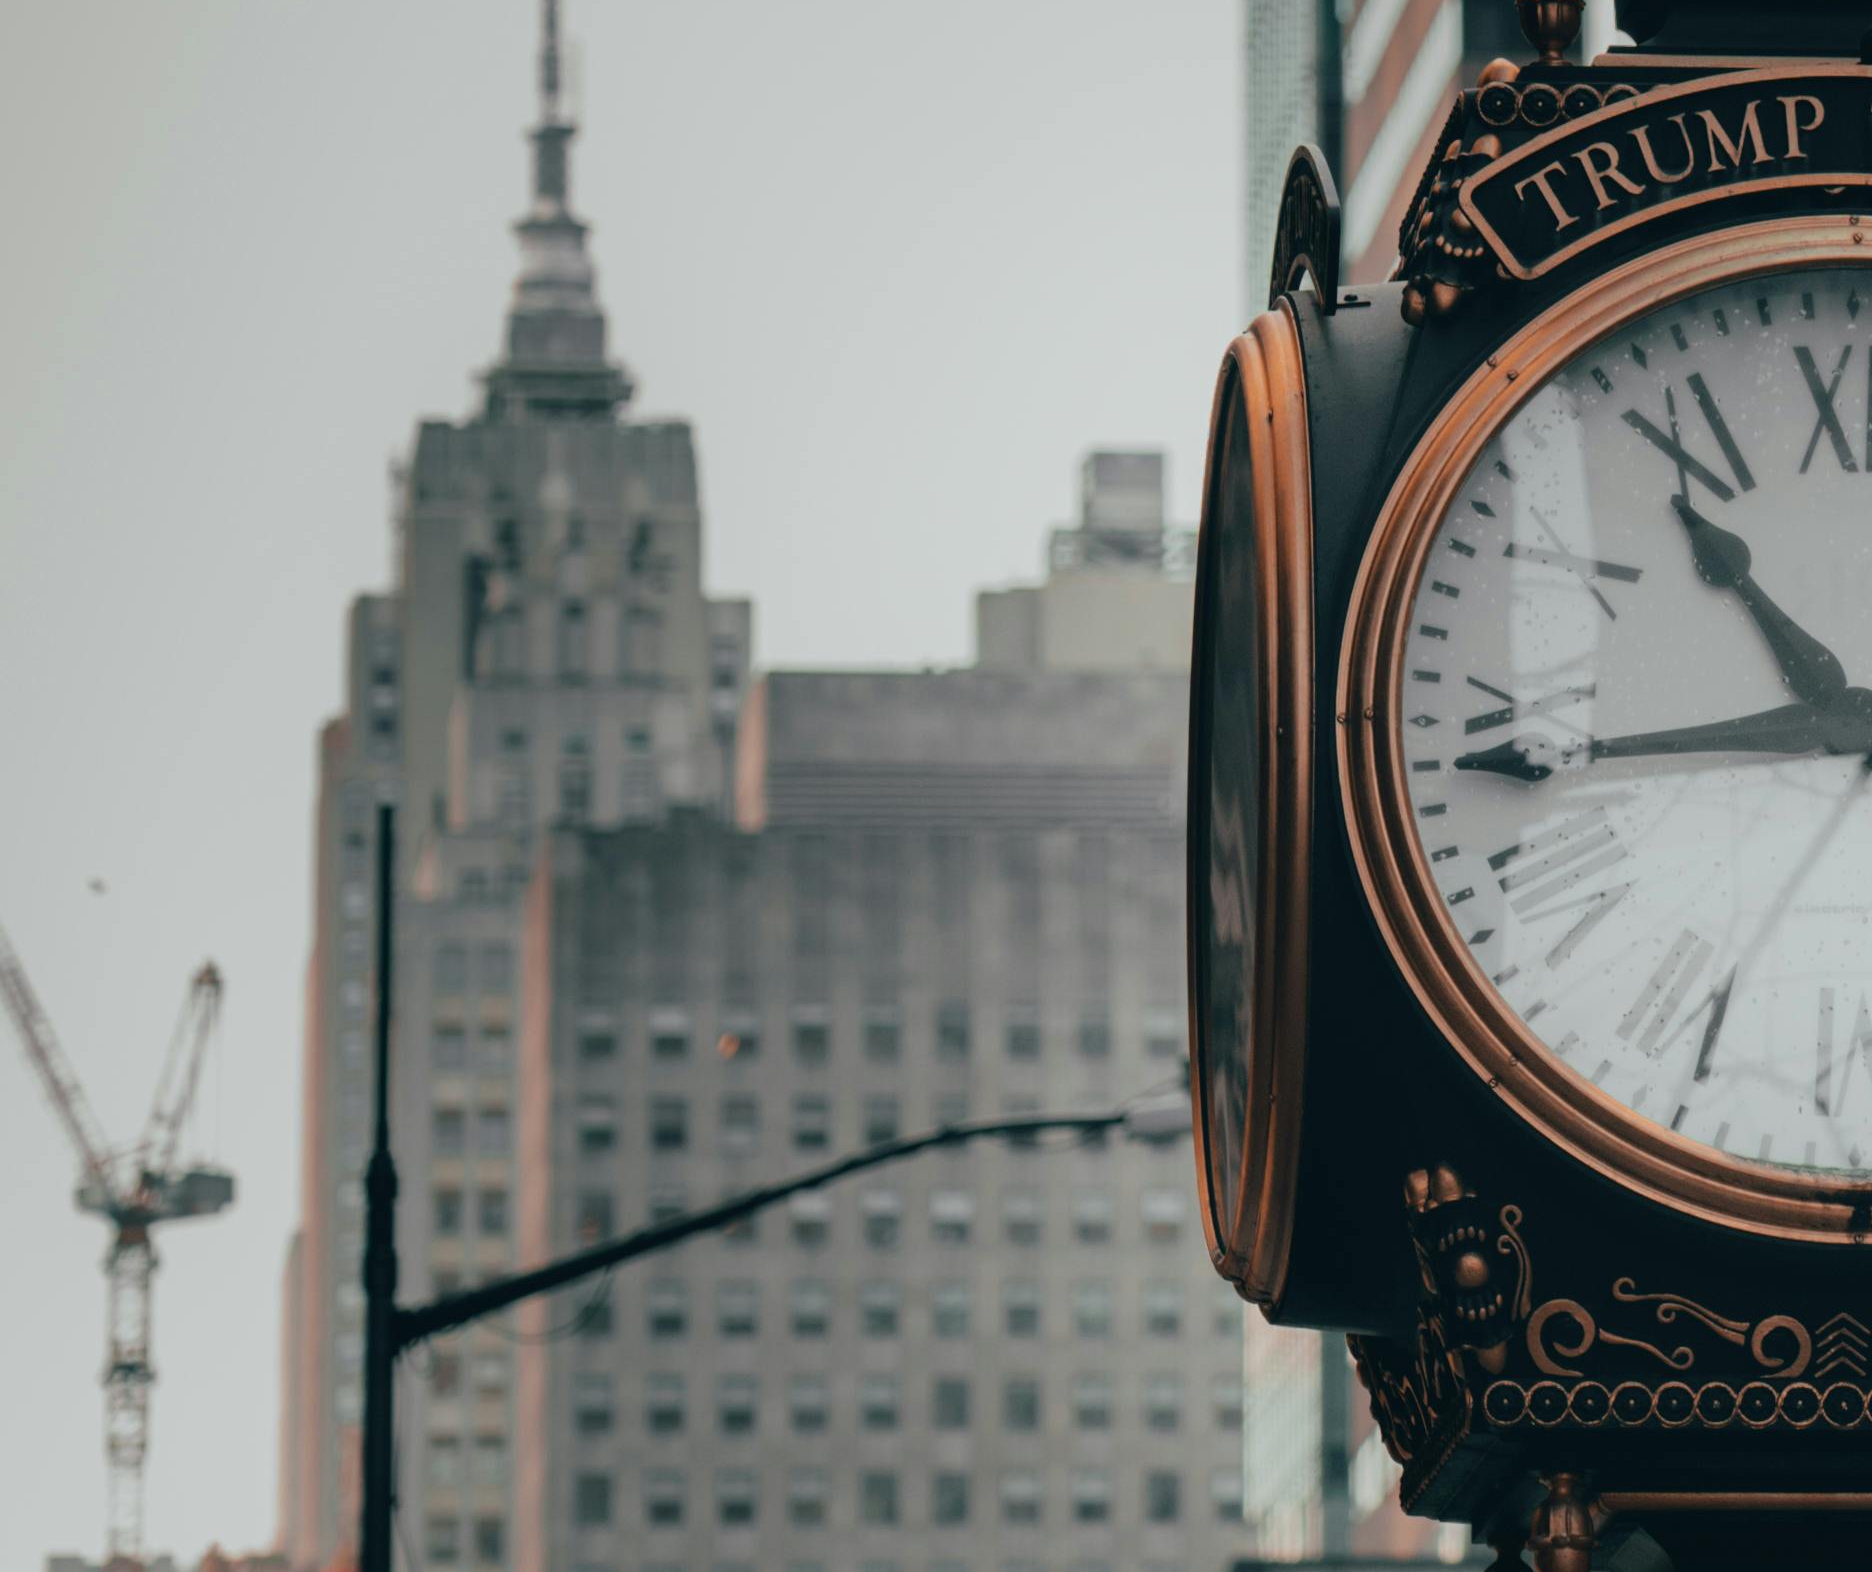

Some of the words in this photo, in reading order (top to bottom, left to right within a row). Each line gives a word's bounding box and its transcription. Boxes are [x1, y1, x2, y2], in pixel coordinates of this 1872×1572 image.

[1515, 95, 1826, 232] TRUMP
[1620, 371, 1757, 508] XI
[1502, 505, 1644, 622] X
[1487, 804, 1642, 972] VIII
[1614, 927, 1738, 1084] VII
